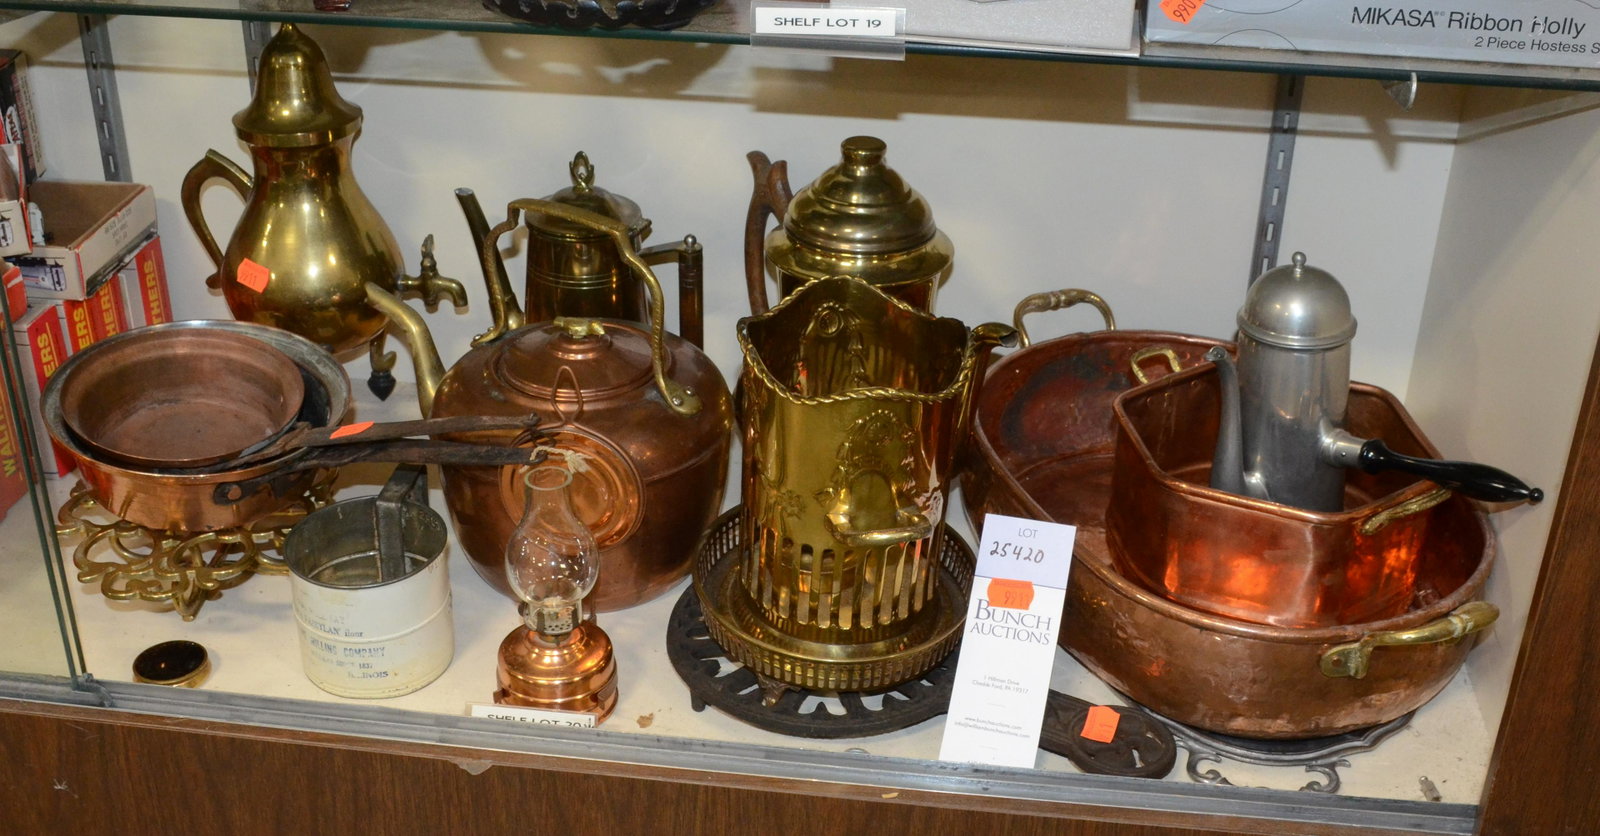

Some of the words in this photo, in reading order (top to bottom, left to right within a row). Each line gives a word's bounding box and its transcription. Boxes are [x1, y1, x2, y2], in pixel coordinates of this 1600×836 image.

[774, 17, 821, 27] SHELF
[826, 18, 859, 28] LOT
[866, 19, 881, 28] 19
[1352, 6, 1435, 28] MIKASA
[1448, 12, 1523, 33] Ribbon
[1530, 15, 1586, 39] Holly
[1474, 36, 1483, 48] 2
[1487, 37, 1526, 50] Piece
[1530, 39, 1586, 53] Hostess
[1018, 528, 1038, 538] LOT
[989, 541, 1045, 563] 25420
[975, 599, 1052, 631] BUNCH
[970, 622, 1051, 646] AUCTIONS
